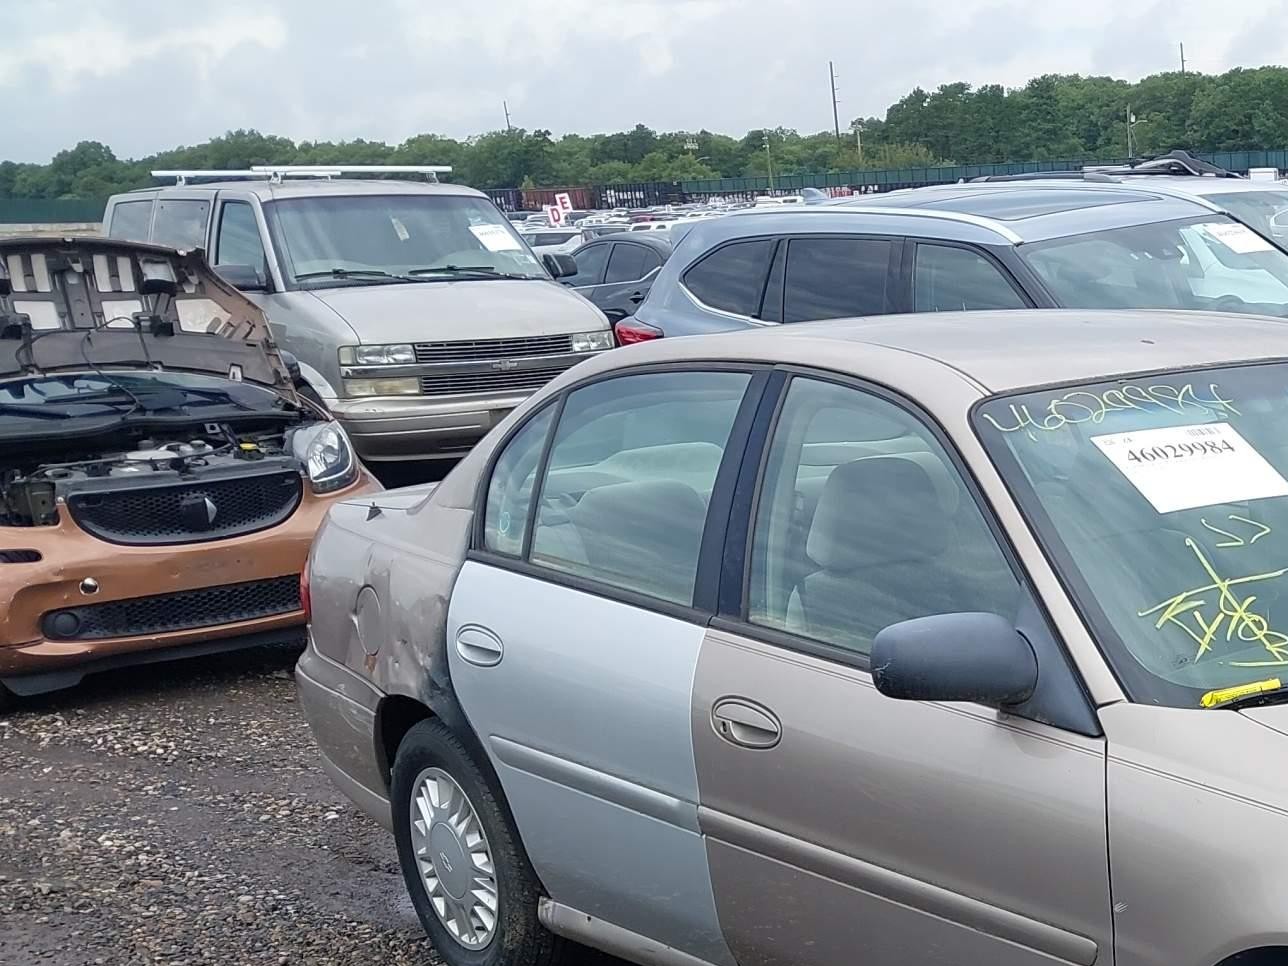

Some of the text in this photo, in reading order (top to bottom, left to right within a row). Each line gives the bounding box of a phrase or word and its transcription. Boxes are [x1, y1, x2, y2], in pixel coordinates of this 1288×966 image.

[559, 196, 570, 210] E
[550, 207, 561, 223] D
[1127, 439, 1236, 463] 46029984
